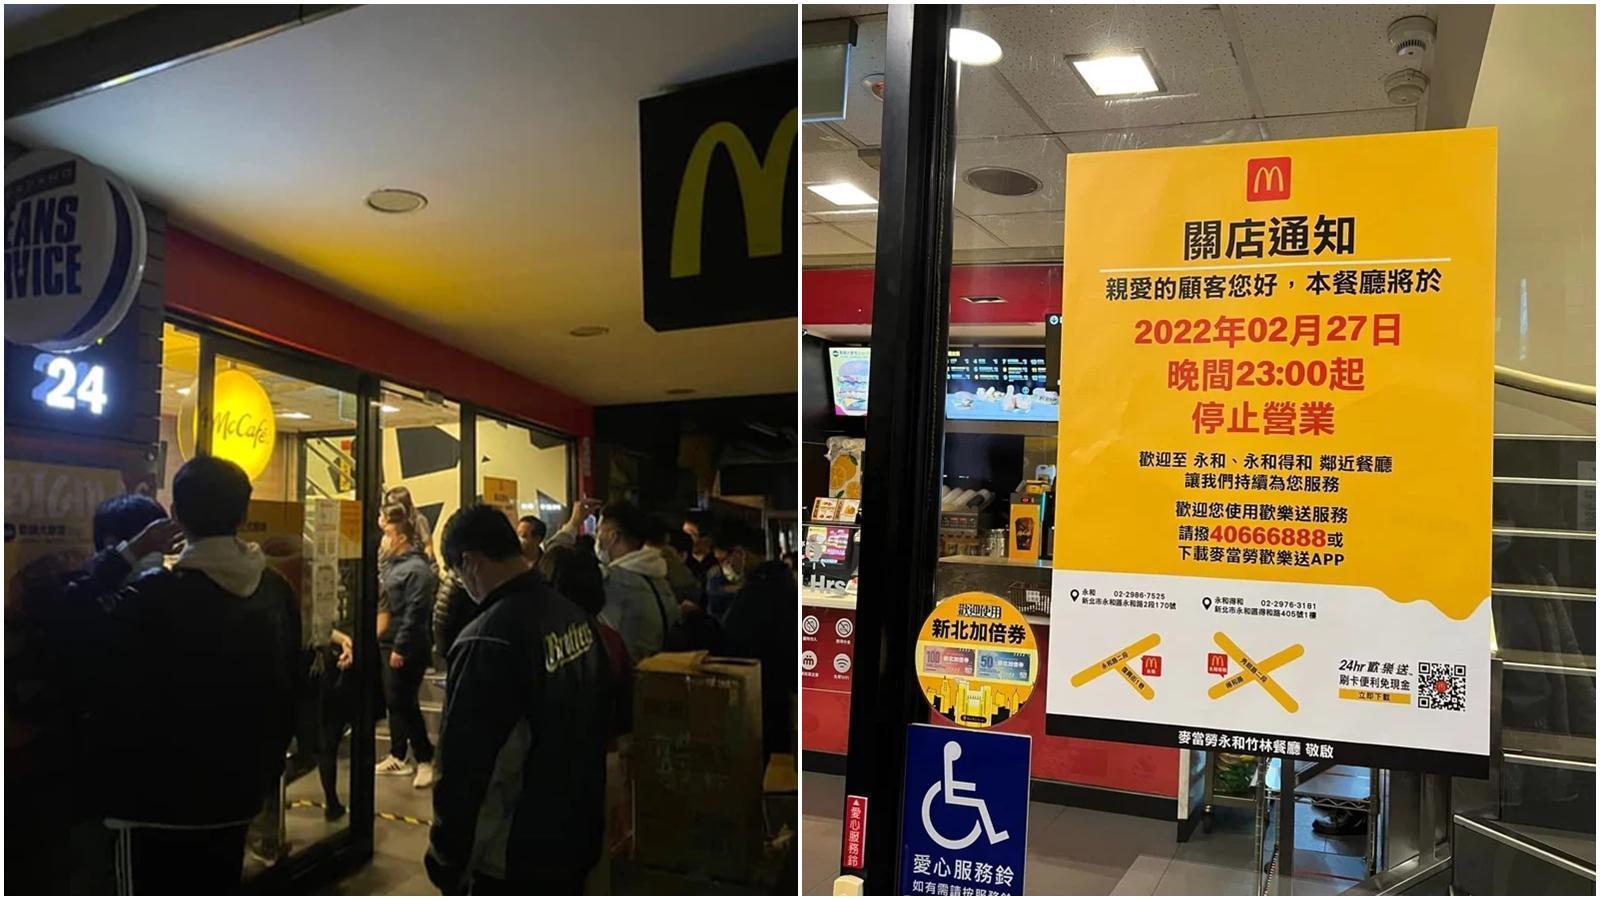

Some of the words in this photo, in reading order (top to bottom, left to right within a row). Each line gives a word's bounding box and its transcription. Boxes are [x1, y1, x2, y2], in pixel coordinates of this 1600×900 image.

[1184, 214, 1356, 261] 關店通知
[1106, 268, 1442, 301] 親愛的顧客您好，本餐廳將於
[1134, 313, 1401, 348] 2022年02月27日
[46, 356, 108, 415] 24
[1168, 356, 1366, 392] 晚間23:00起
[215, 411, 267, 449] McCafé
[1191, 401, 1336, 436] 停止營業
[1139, 451, 1187, 468] 歡迎至
[1194, 453, 1313, 471] 永和、永和得和
[1319, 455, 1393, 473] 鄰近餐廳
[1185, 472, 1339, 492] 讓我們持續為您服務
[1176, 501, 1348, 523] 歡迎您使用歡樂送服務
[1178, 525, 1343, 548] 請撥40666888或
[1178, 545, 1345, 567] 下載麥當勞歡樂送APP
[1113, 590, 1166, 600] 02-2986-7525
[1260, 599, 1317, 610] 02-2976-3181
[932, 618, 1026, 645] 新北加倍券
[980, 655, 994, 669] 50
[1338, 659, 1365, 672] 24hr
[1339, 674, 1410, 691] 刷卡便利免現金
[1178, 730, 1301, 756] 麥當勞永和竹林餐廳
[1305, 743, 1334, 759] 敬啟
[847, 806, 862, 867] 愛心服務鈴
[912, 854, 1014, 887] 愛心服務鈴
[912, 880, 1011, 896] 如有需請按服
